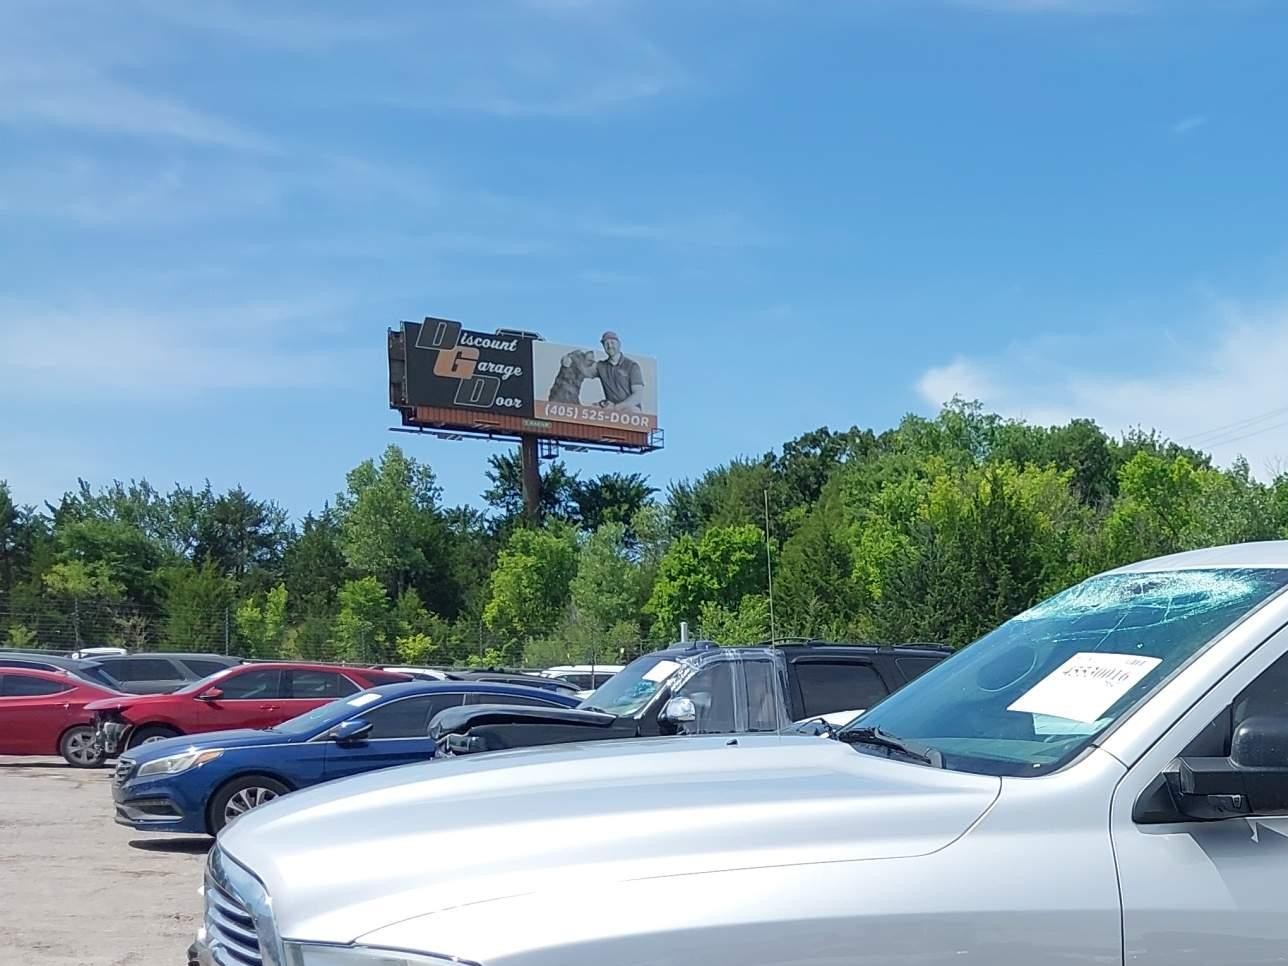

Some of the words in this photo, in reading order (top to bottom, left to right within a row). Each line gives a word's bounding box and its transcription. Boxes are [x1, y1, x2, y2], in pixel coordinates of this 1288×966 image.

[415, 317, 518, 352] Discount
[433, 345, 523, 380] Garage
[453, 374, 523, 408] Door
[544, 404, 579, 419] (405)
[581, 409, 650, 427] 525-DOOR
